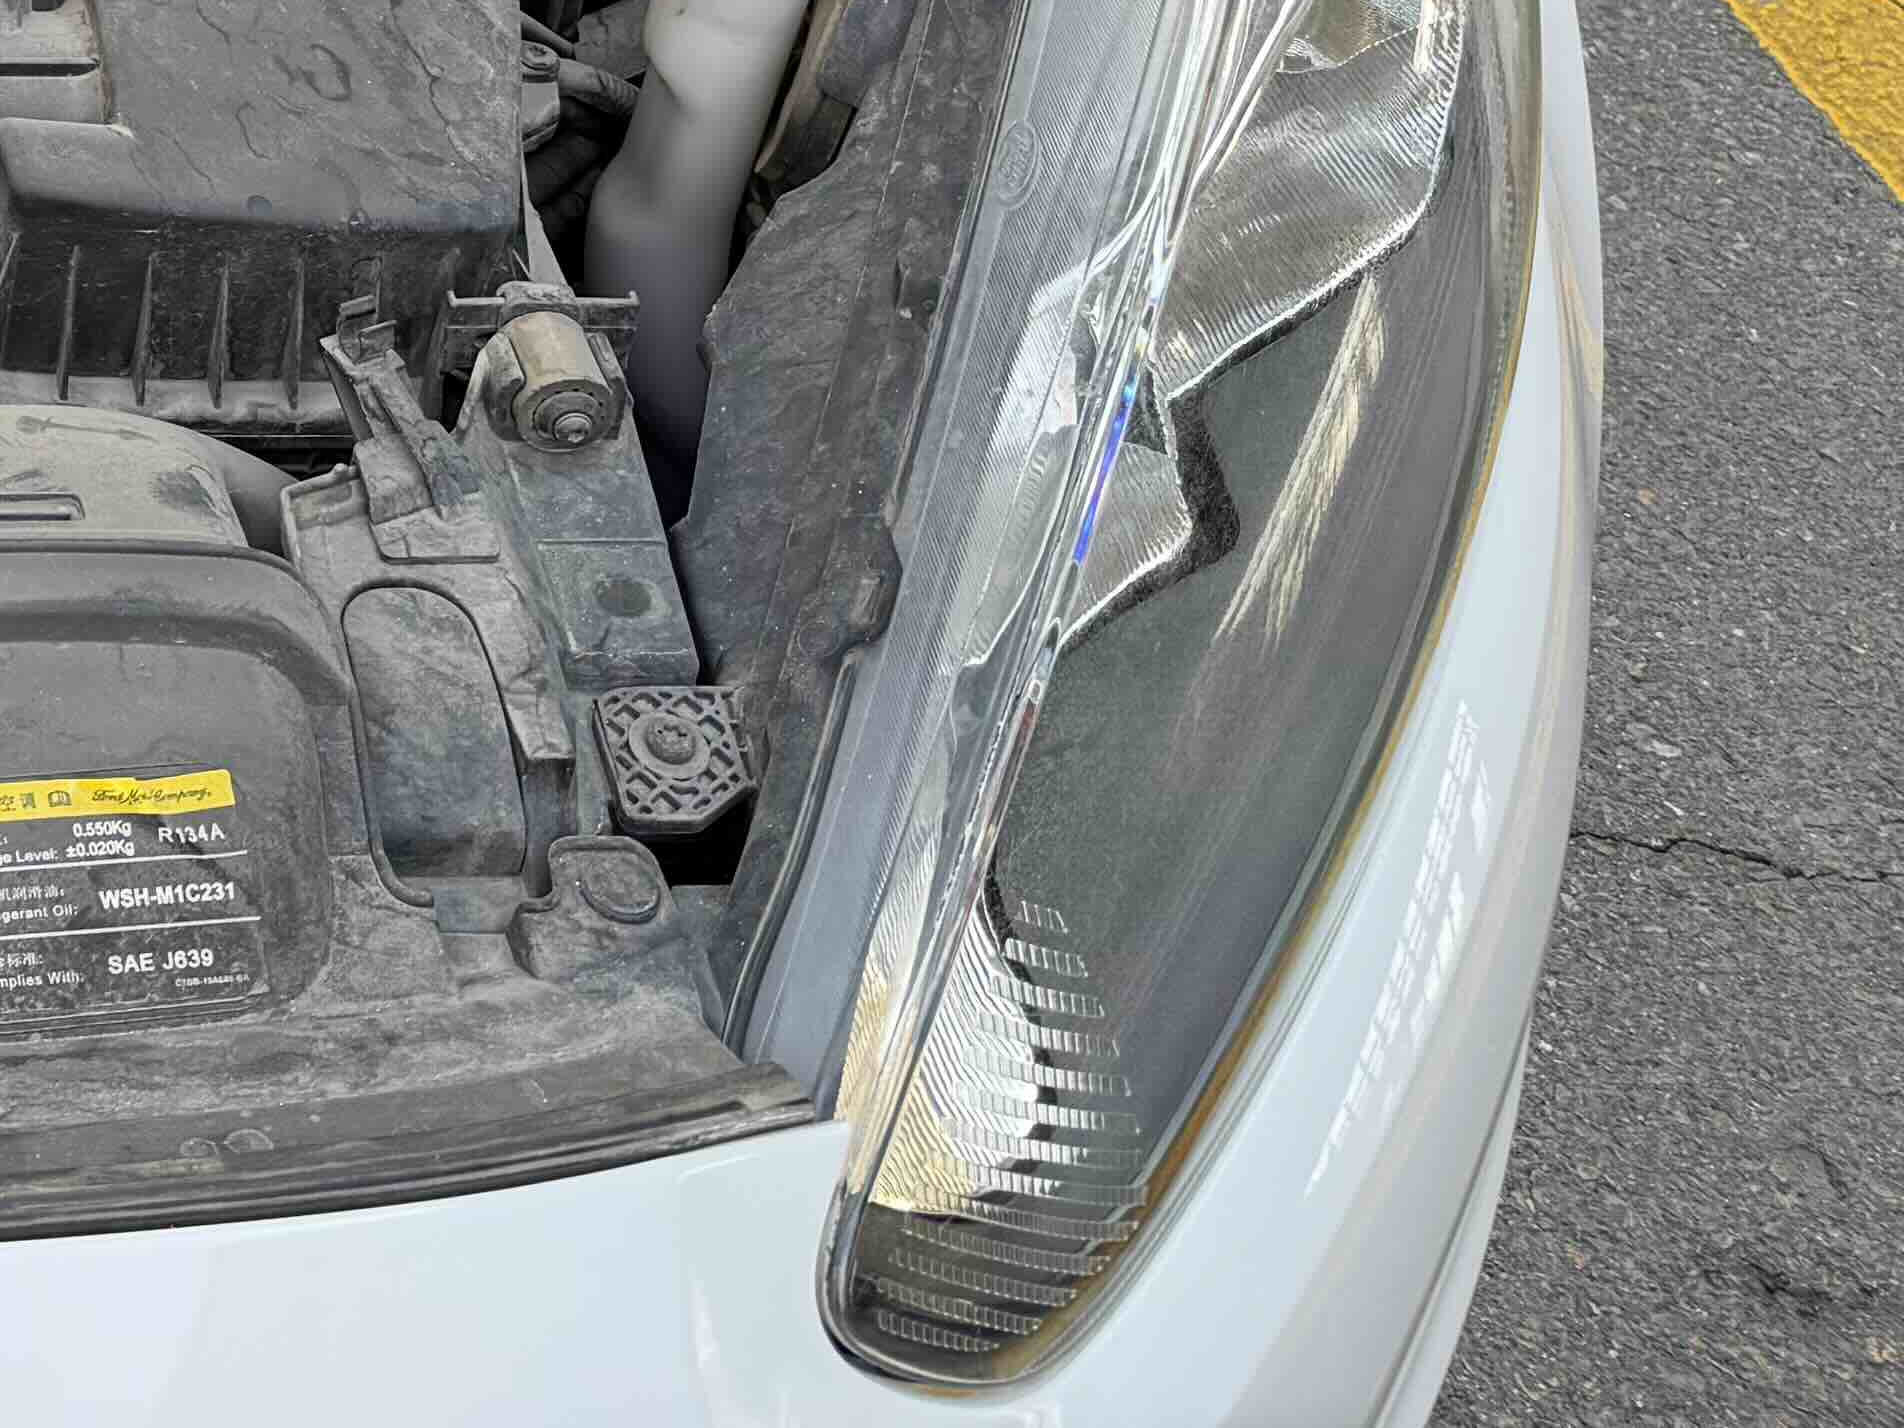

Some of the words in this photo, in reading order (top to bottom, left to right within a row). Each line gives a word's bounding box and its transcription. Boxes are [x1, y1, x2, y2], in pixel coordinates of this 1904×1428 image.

[72, 820, 132, 839] 0.550Kg
[158, 823, 225, 844] R134A
[15, 847, 60, 864] Level:
[65, 839, 135, 858] ±0.020Kg
[98, 881, 235, 910] WSH-M1C231
[52, 903, 79, 918] Oil:
[108, 951, 156, 975] SAE
[162, 948, 214, 970] J639
